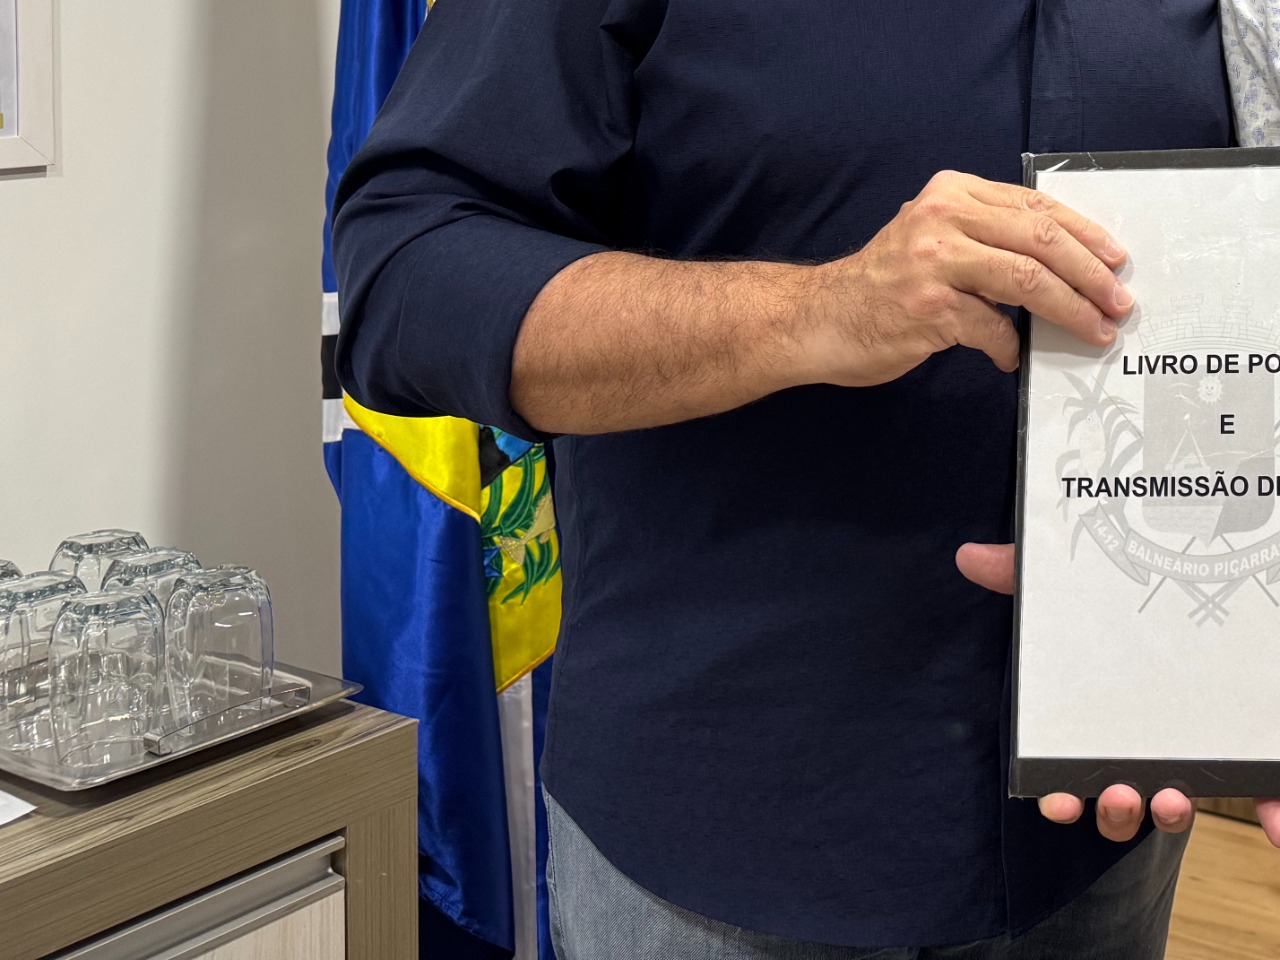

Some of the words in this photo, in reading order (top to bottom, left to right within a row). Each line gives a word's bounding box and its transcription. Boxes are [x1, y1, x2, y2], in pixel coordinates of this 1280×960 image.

[1123, 355, 1198, 375] LIVRO
[1206, 354, 1240, 374] DE
[1220, 414, 1235, 434] E
[1062, 471, 1249, 497] TRANSMISSÃO
[1092, 519, 1120, 552] 14-12
[1127, 539, 1210, 577] BALNEÁRIO
